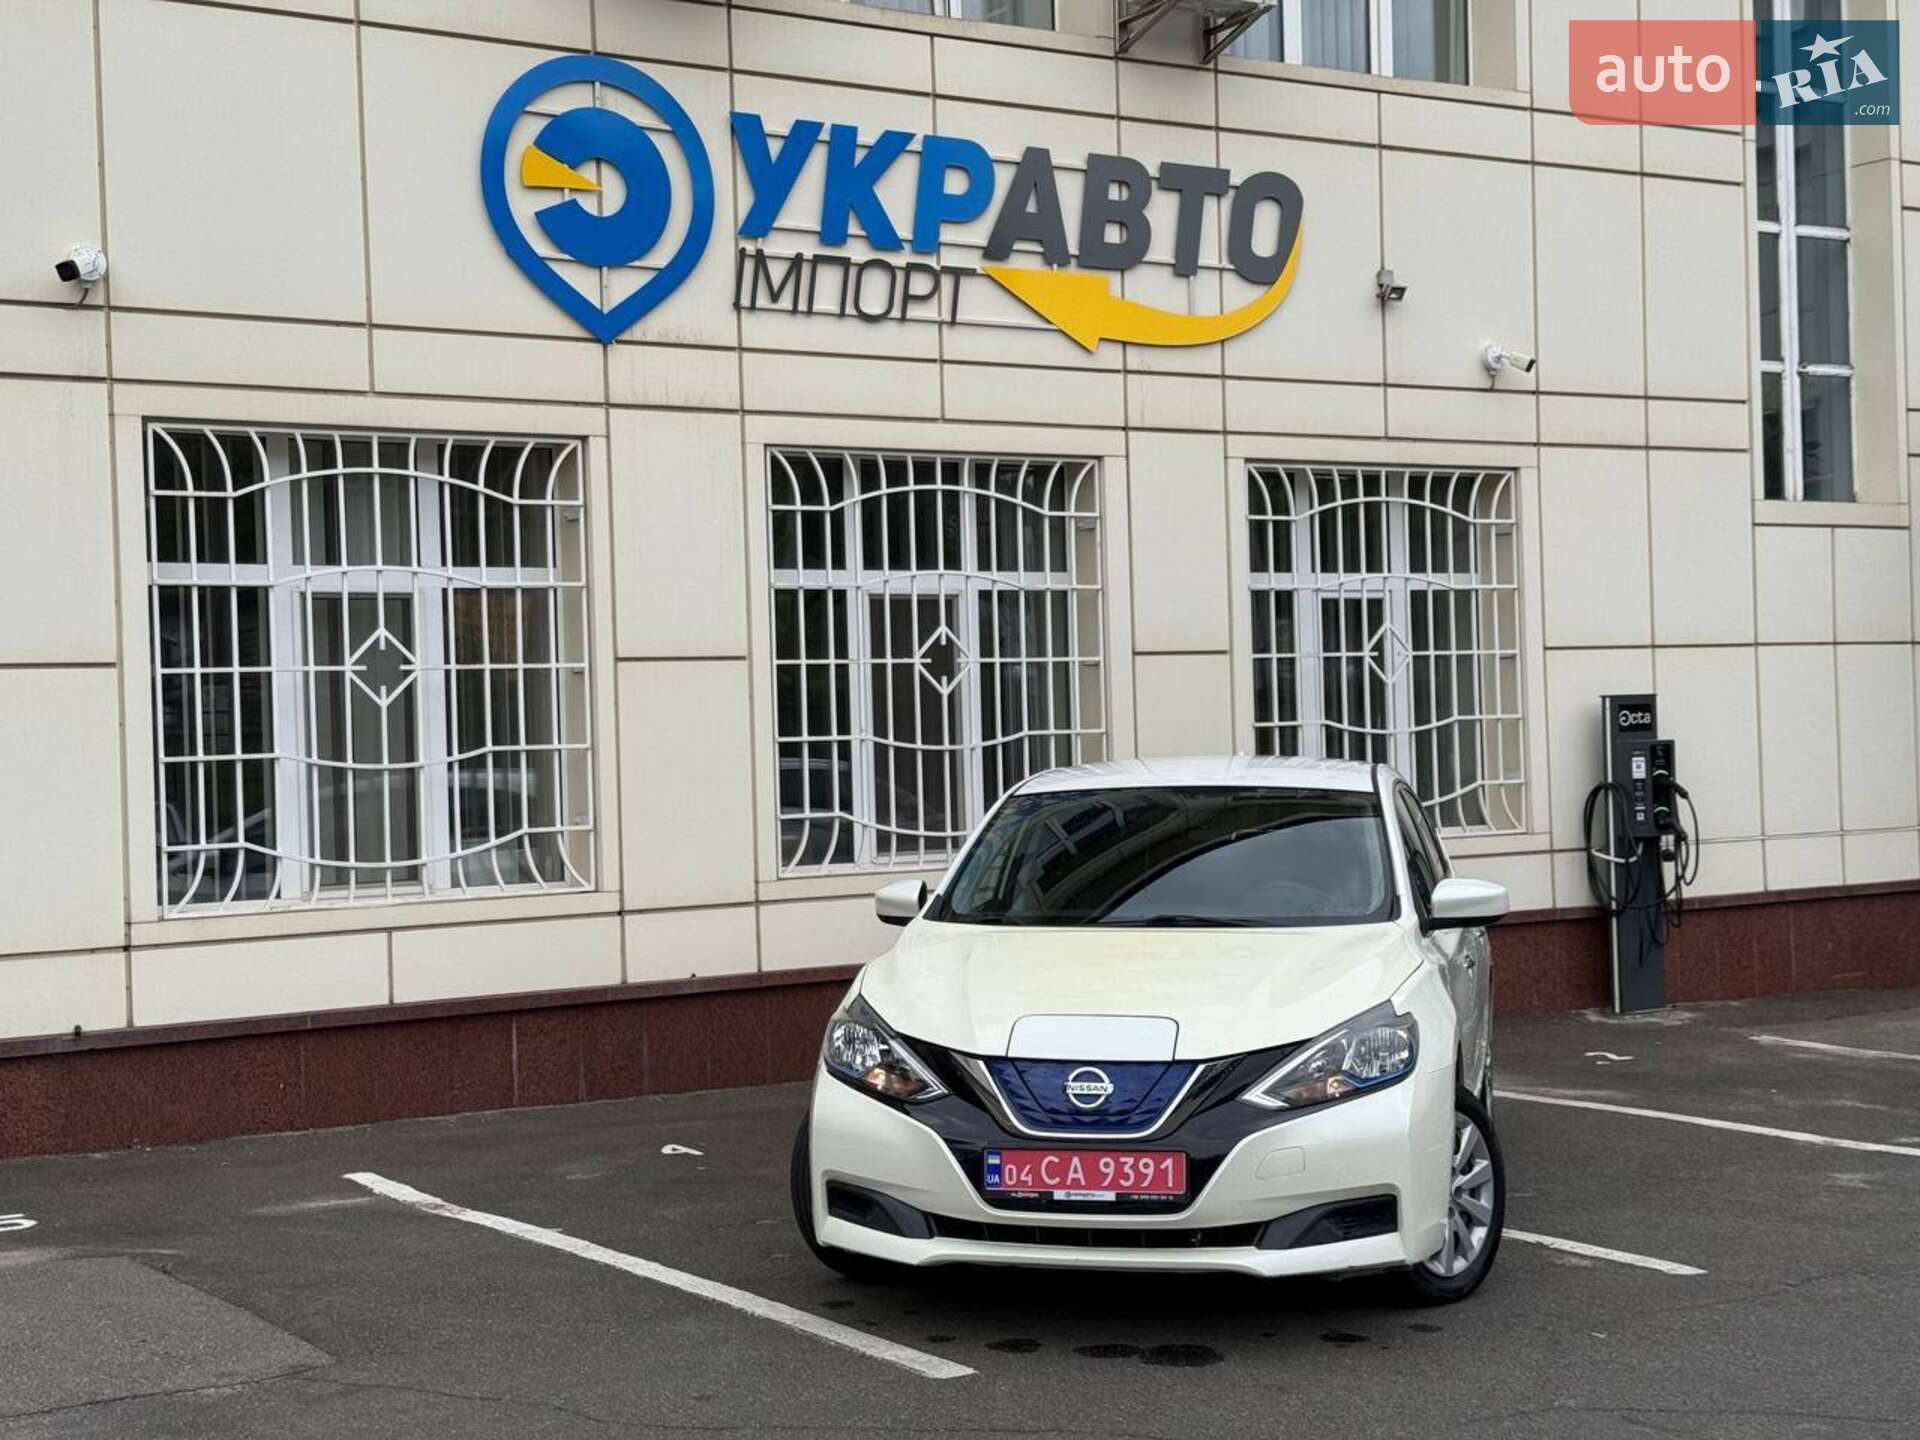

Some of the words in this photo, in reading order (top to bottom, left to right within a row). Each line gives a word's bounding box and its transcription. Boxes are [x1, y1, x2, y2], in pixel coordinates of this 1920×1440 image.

[730, 110, 1304, 285] УКРАВТО
[733, 247, 977, 326] ІМПОРТ
[1068, 1084, 1108, 1092] NISSAN
[986, 1174, 1000, 1184] UA
[1004, 1164, 1033, 1186] 04
[1040, 1155, 1086, 1186] CA
[1099, 1157, 1174, 1188] 9391
